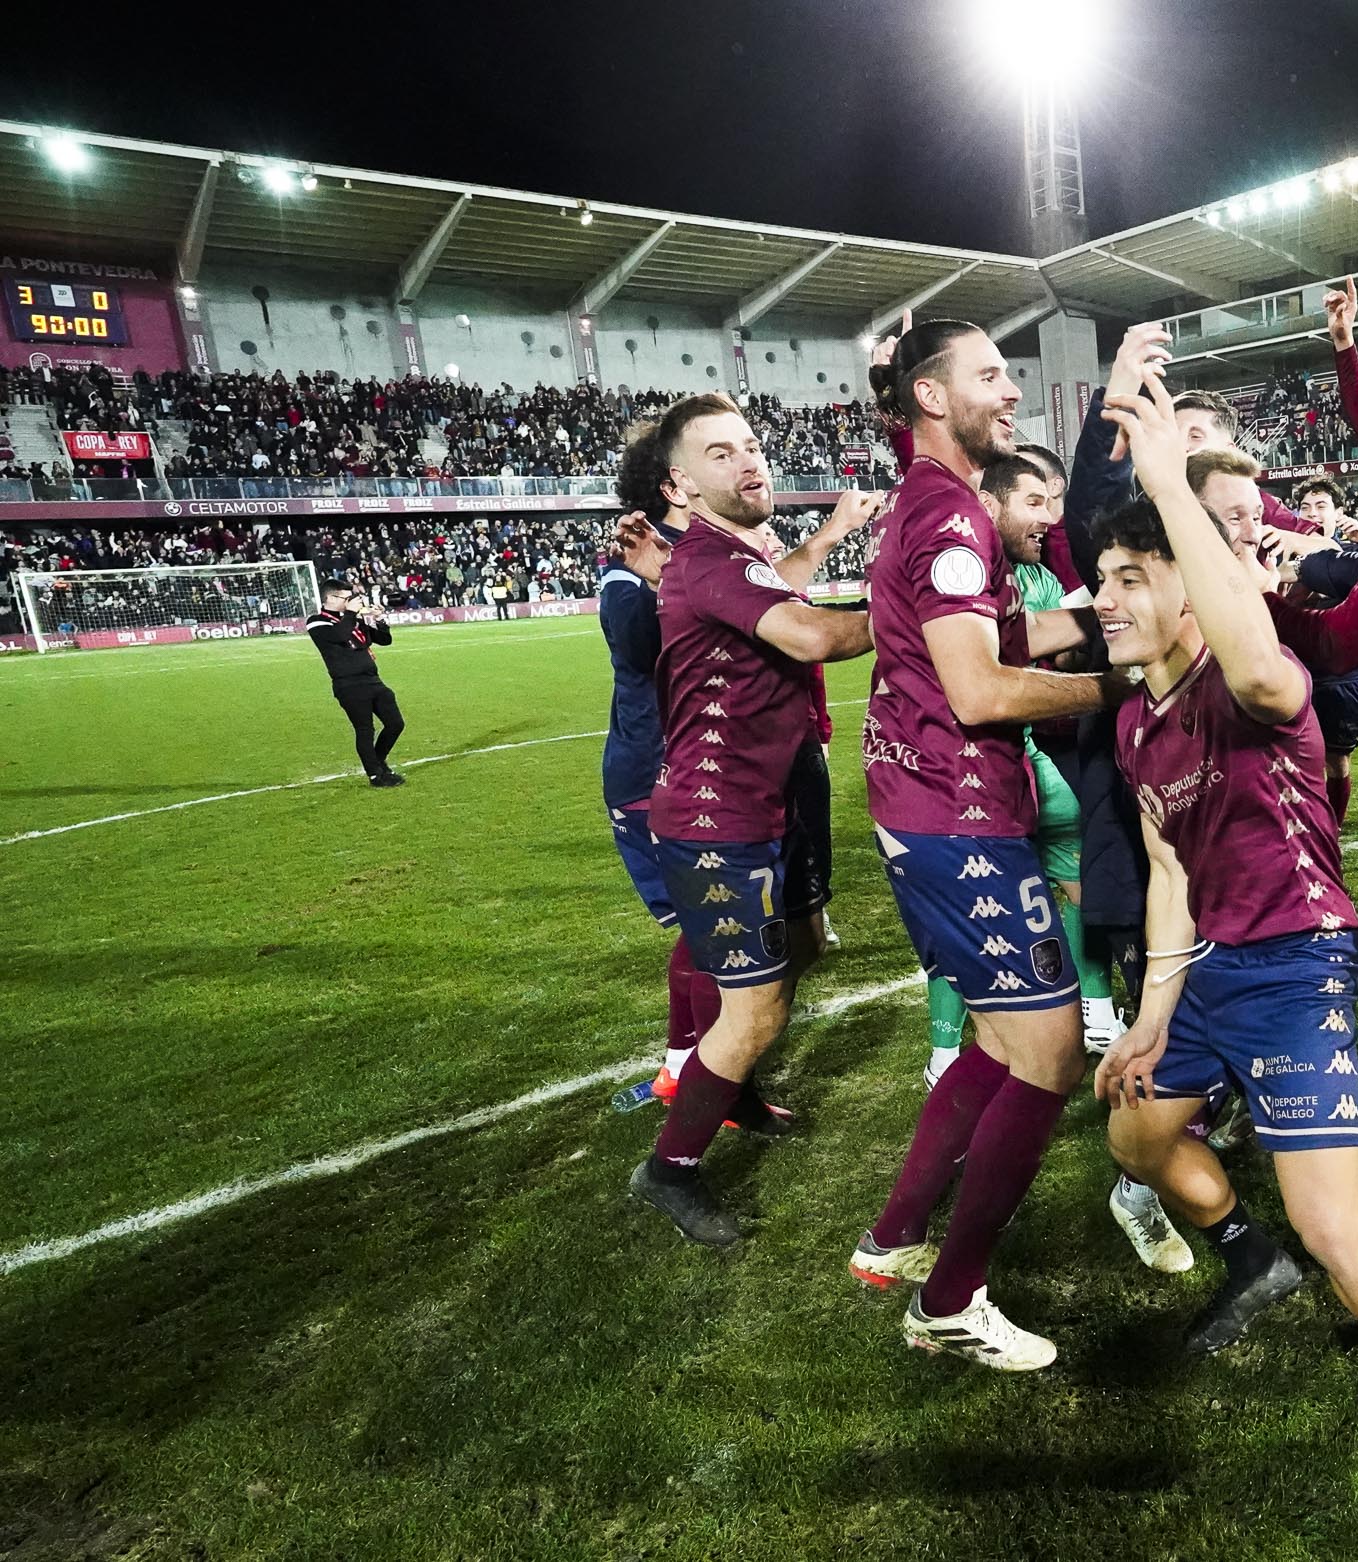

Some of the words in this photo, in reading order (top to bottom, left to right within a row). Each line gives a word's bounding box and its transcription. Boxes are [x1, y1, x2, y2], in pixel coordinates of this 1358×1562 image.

[20, 257, 158, 281] PONTEVEDRA
[18, 285, 34, 305] 3
[92, 291, 109, 311] 0
[76, 434, 106, 450] COPA
[119, 435, 138, 450] REY
[1268, 468, 1293, 480] Estrella
[1293, 466, 1316, 478] Galicia
[189, 502, 288, 515] CELTAMOTOR
[311, 499, 343, 508] FROIZ
[358, 499, 389, 508] FROIZ
[403, 498, 433, 507] FROIZ
[456, 498, 500, 510] Estrella
[502, 497, 542, 510] Galicia
[748, 867, 774, 917] 7
[1018, 875, 1052, 934] 5
[1264, 1055, 1292, 1066] XUNTA
[1265, 1066, 1275, 1076] DE
[1275, 1063, 1316, 1075] GALICIA
[1275, 1095, 1319, 1106] DEPORTE
[1276, 1108, 1315, 1120] GALEGO
[1221, 1224, 1248, 1244] adidas
